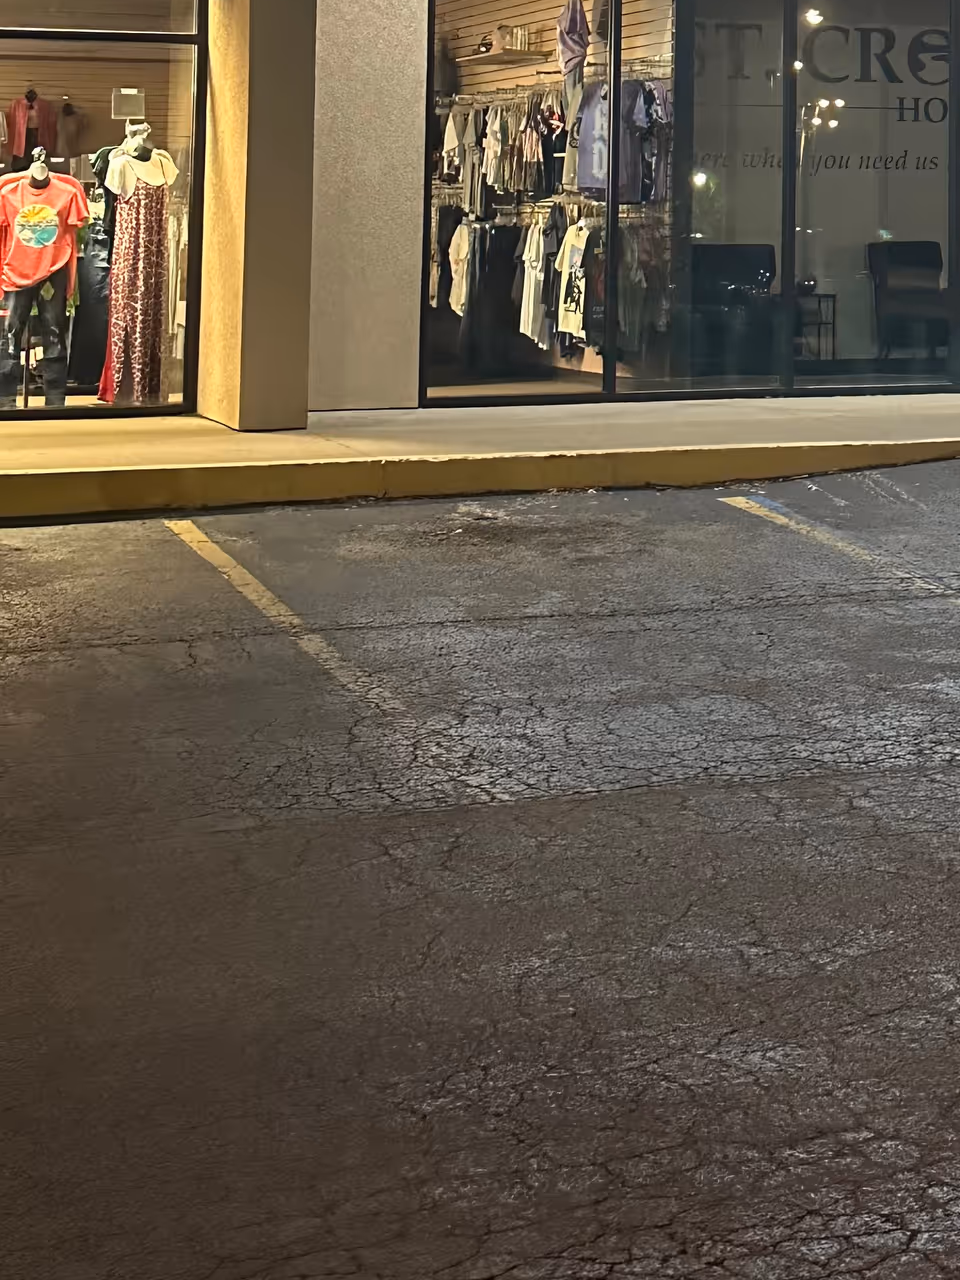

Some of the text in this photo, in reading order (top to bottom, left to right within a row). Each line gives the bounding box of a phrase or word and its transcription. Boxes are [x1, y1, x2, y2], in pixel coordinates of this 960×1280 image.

[809, 154, 852, 178] you
[858, 149, 909, 171] need
[915, 154, 939, 171] us
